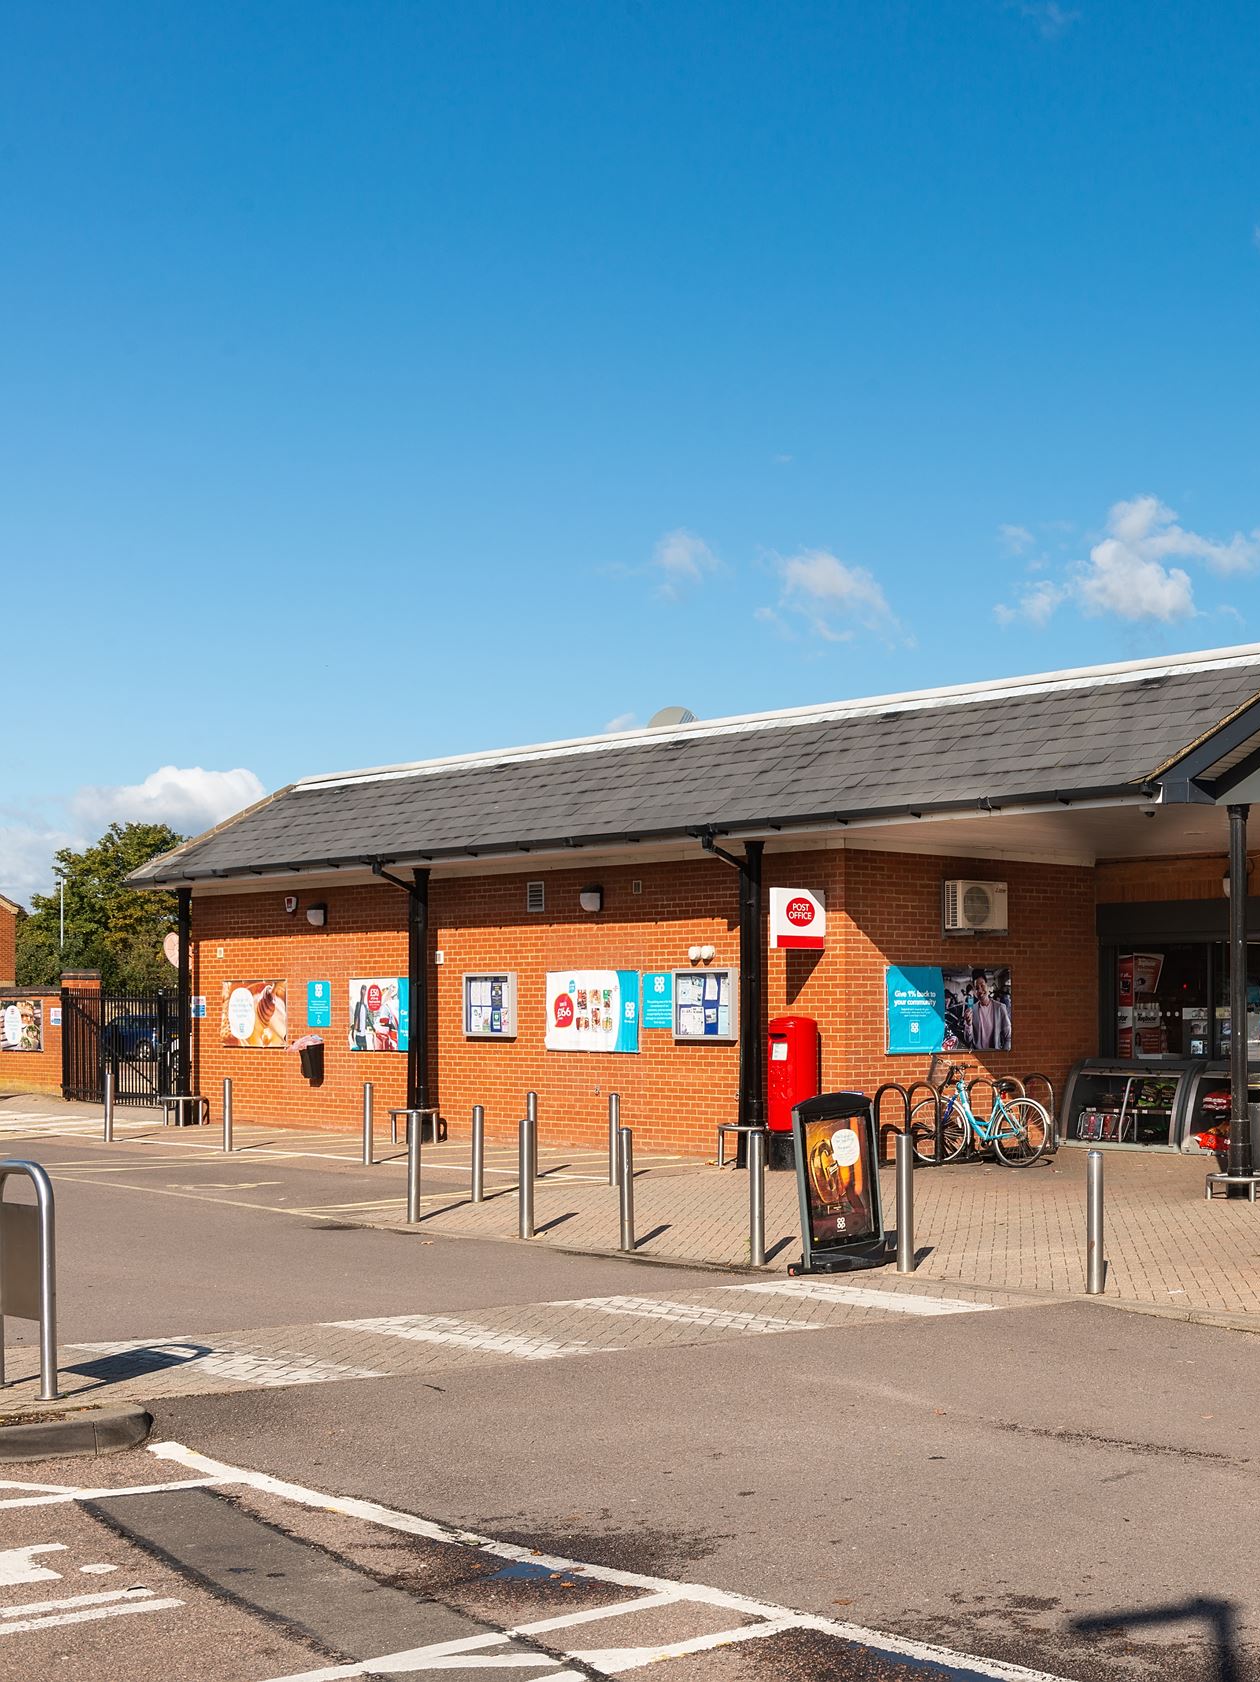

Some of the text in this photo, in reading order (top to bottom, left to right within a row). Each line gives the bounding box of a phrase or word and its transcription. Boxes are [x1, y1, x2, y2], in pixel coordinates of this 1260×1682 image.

[792, 903, 810, 911] POST
[788, 911, 812, 920] OFFICE
[907, 999, 936, 1007] community
